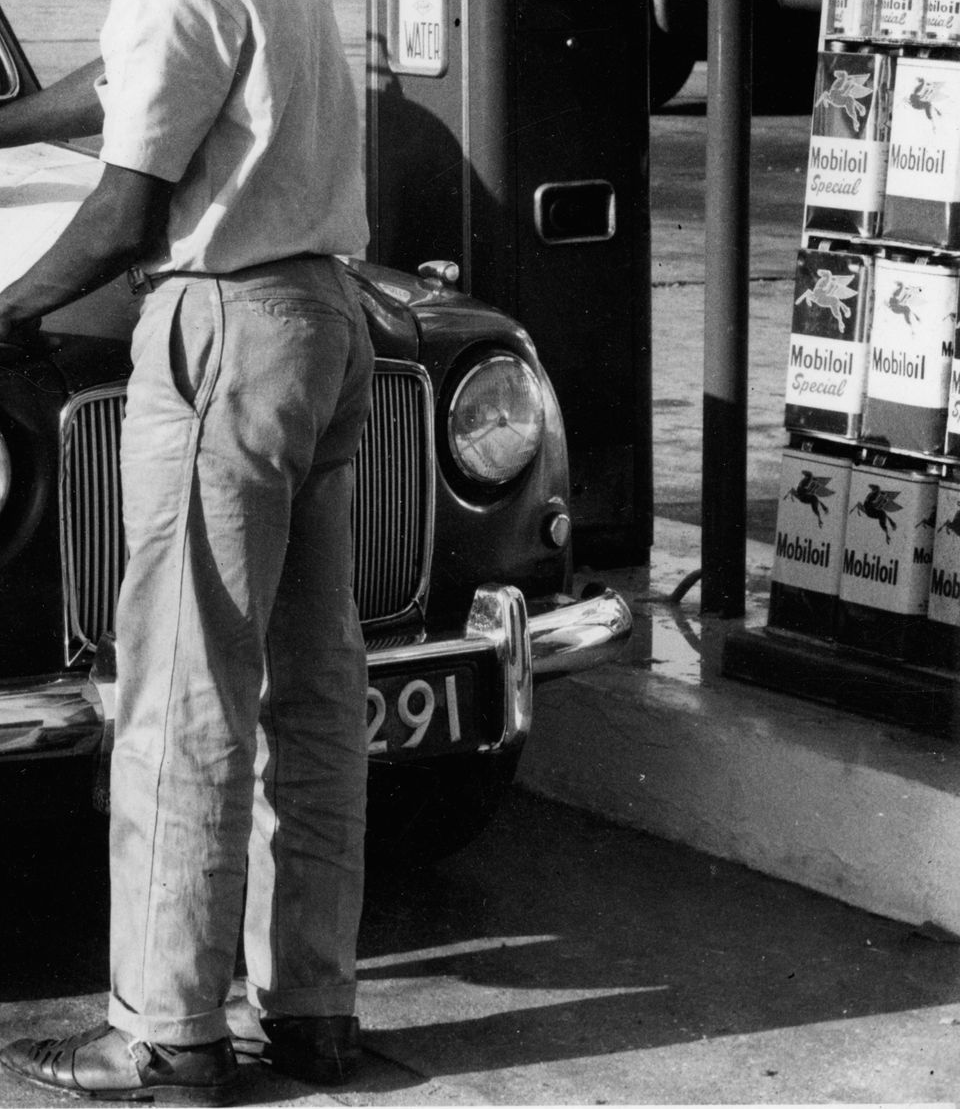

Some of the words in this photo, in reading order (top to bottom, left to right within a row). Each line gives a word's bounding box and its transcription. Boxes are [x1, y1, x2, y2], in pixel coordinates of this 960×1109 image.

[404, 21, 441, 61] WATER
[809, 146, 868, 174] Mobiloil
[891, 144, 946, 174] Mobiloil
[810, 174, 862, 196] Special
[790, 344, 853, 375] Mobiloil
[872, 346, 926, 380] Mobiloil
[792, 373, 848, 398] Special
[776, 532, 831, 568] Mobiloil
[842, 548, 899, 586] Mobiloil
